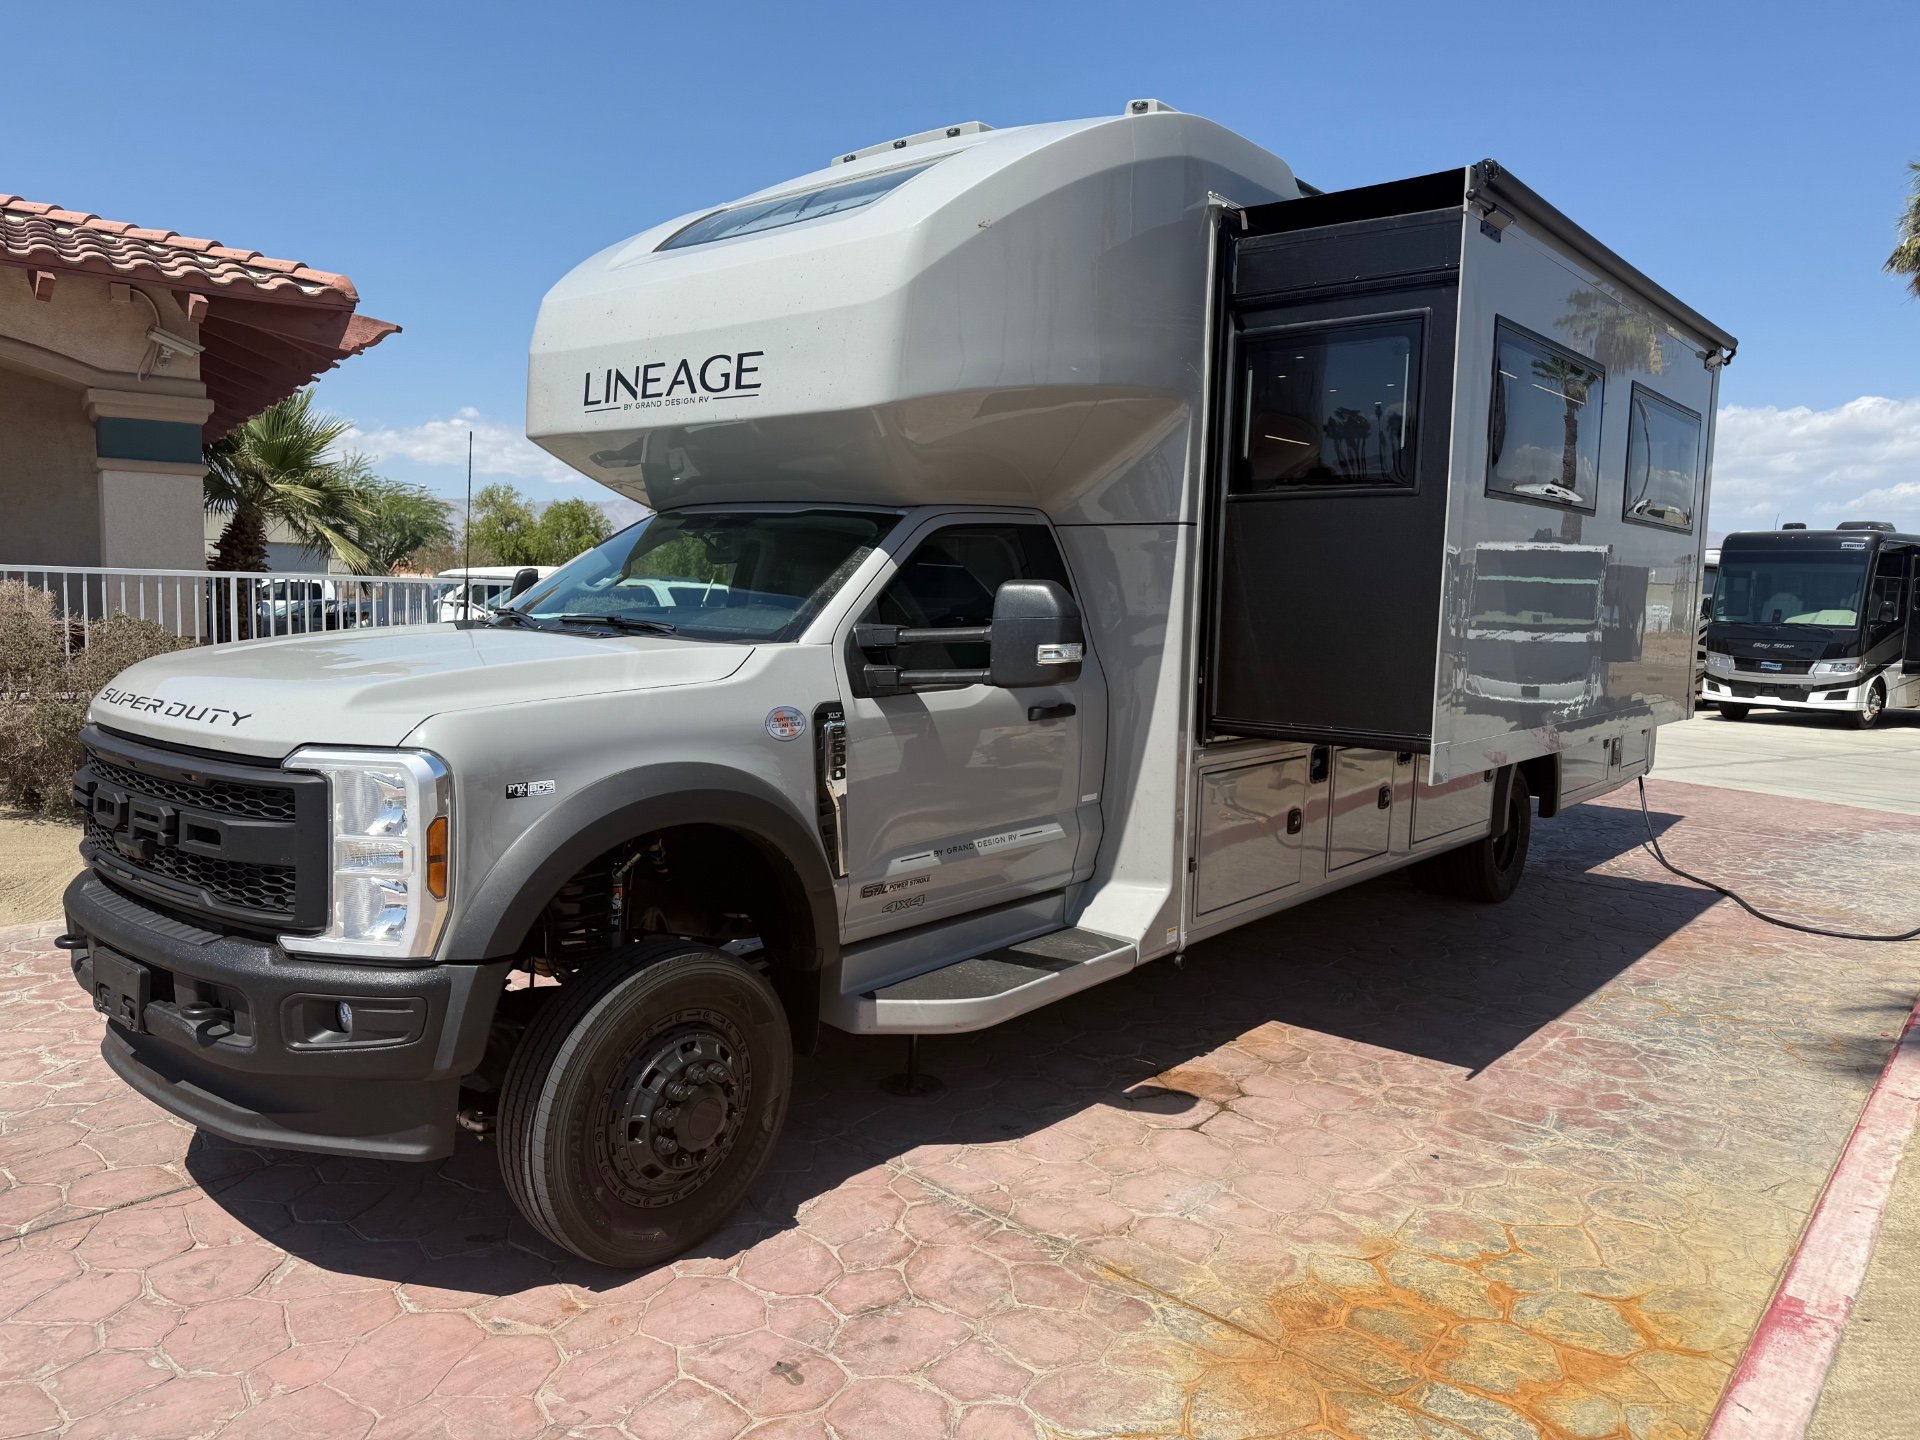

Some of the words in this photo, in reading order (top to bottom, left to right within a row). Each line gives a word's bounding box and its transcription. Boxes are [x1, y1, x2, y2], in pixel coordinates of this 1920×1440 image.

[583, 350, 765, 407] LINEAGE
[624, 402, 633, 411] BY
[635, 399, 662, 410] GRAND
[665, 396, 696, 407] DESIGN
[698, 395, 710, 404] RV
[100, 687, 165, 714] SUPER
[165, 702, 254, 727] DUTY
[827, 711, 842, 719] XLT
[507, 783, 527, 797] FOX
[933, 847, 944, 857] BY
[946, 842, 975, 854] GRAND
[977, 835, 1006, 848] DESIGN
[1007, 833, 1018, 842] RV
[889, 880, 909, 891] POWER
[909, 875, 931, 886] STROKE
